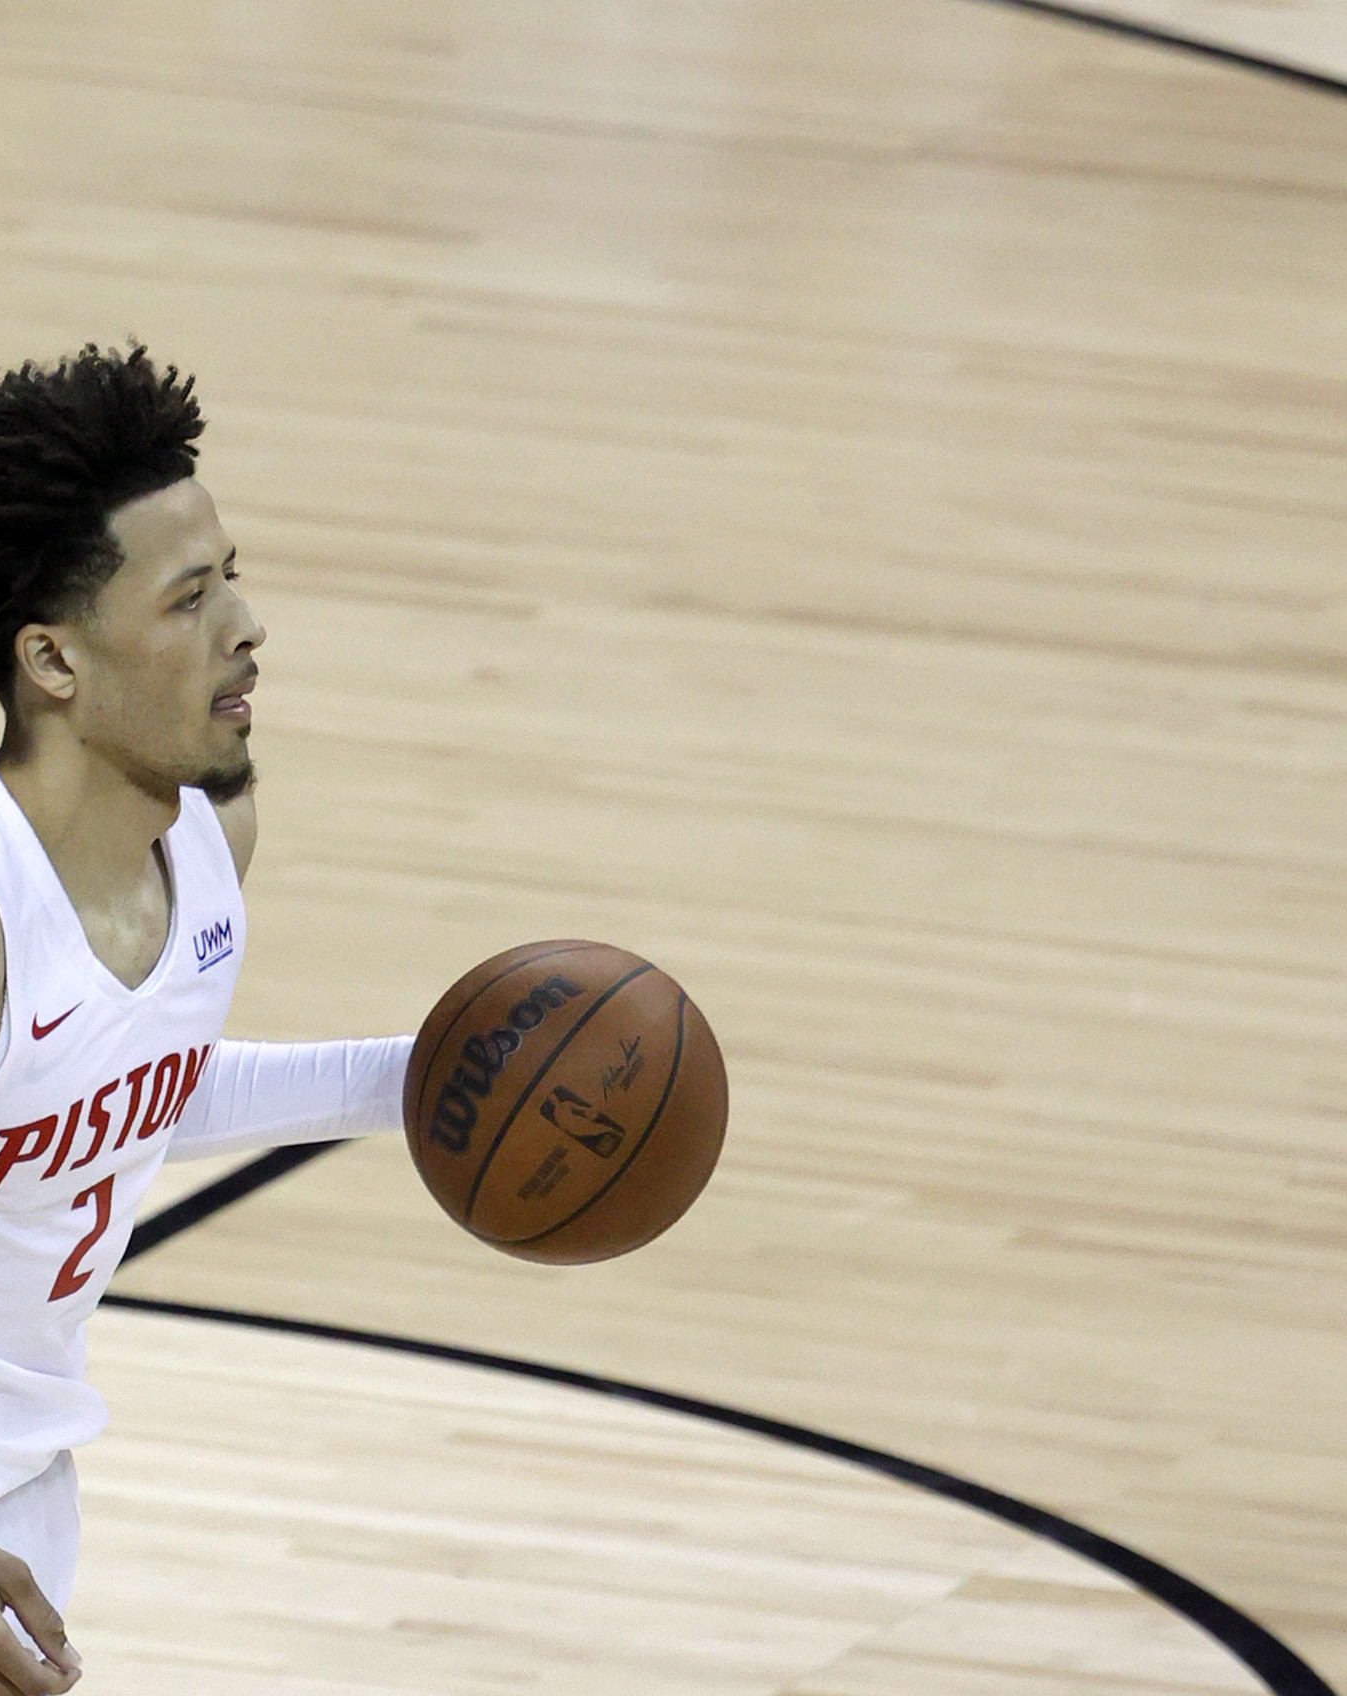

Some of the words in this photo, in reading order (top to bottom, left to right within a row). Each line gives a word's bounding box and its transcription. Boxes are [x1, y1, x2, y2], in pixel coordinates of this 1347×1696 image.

[193, 917, 233, 961] UWM
[432, 975, 586, 1156] Wilson
[47, 1173, 115, 1303] 2
